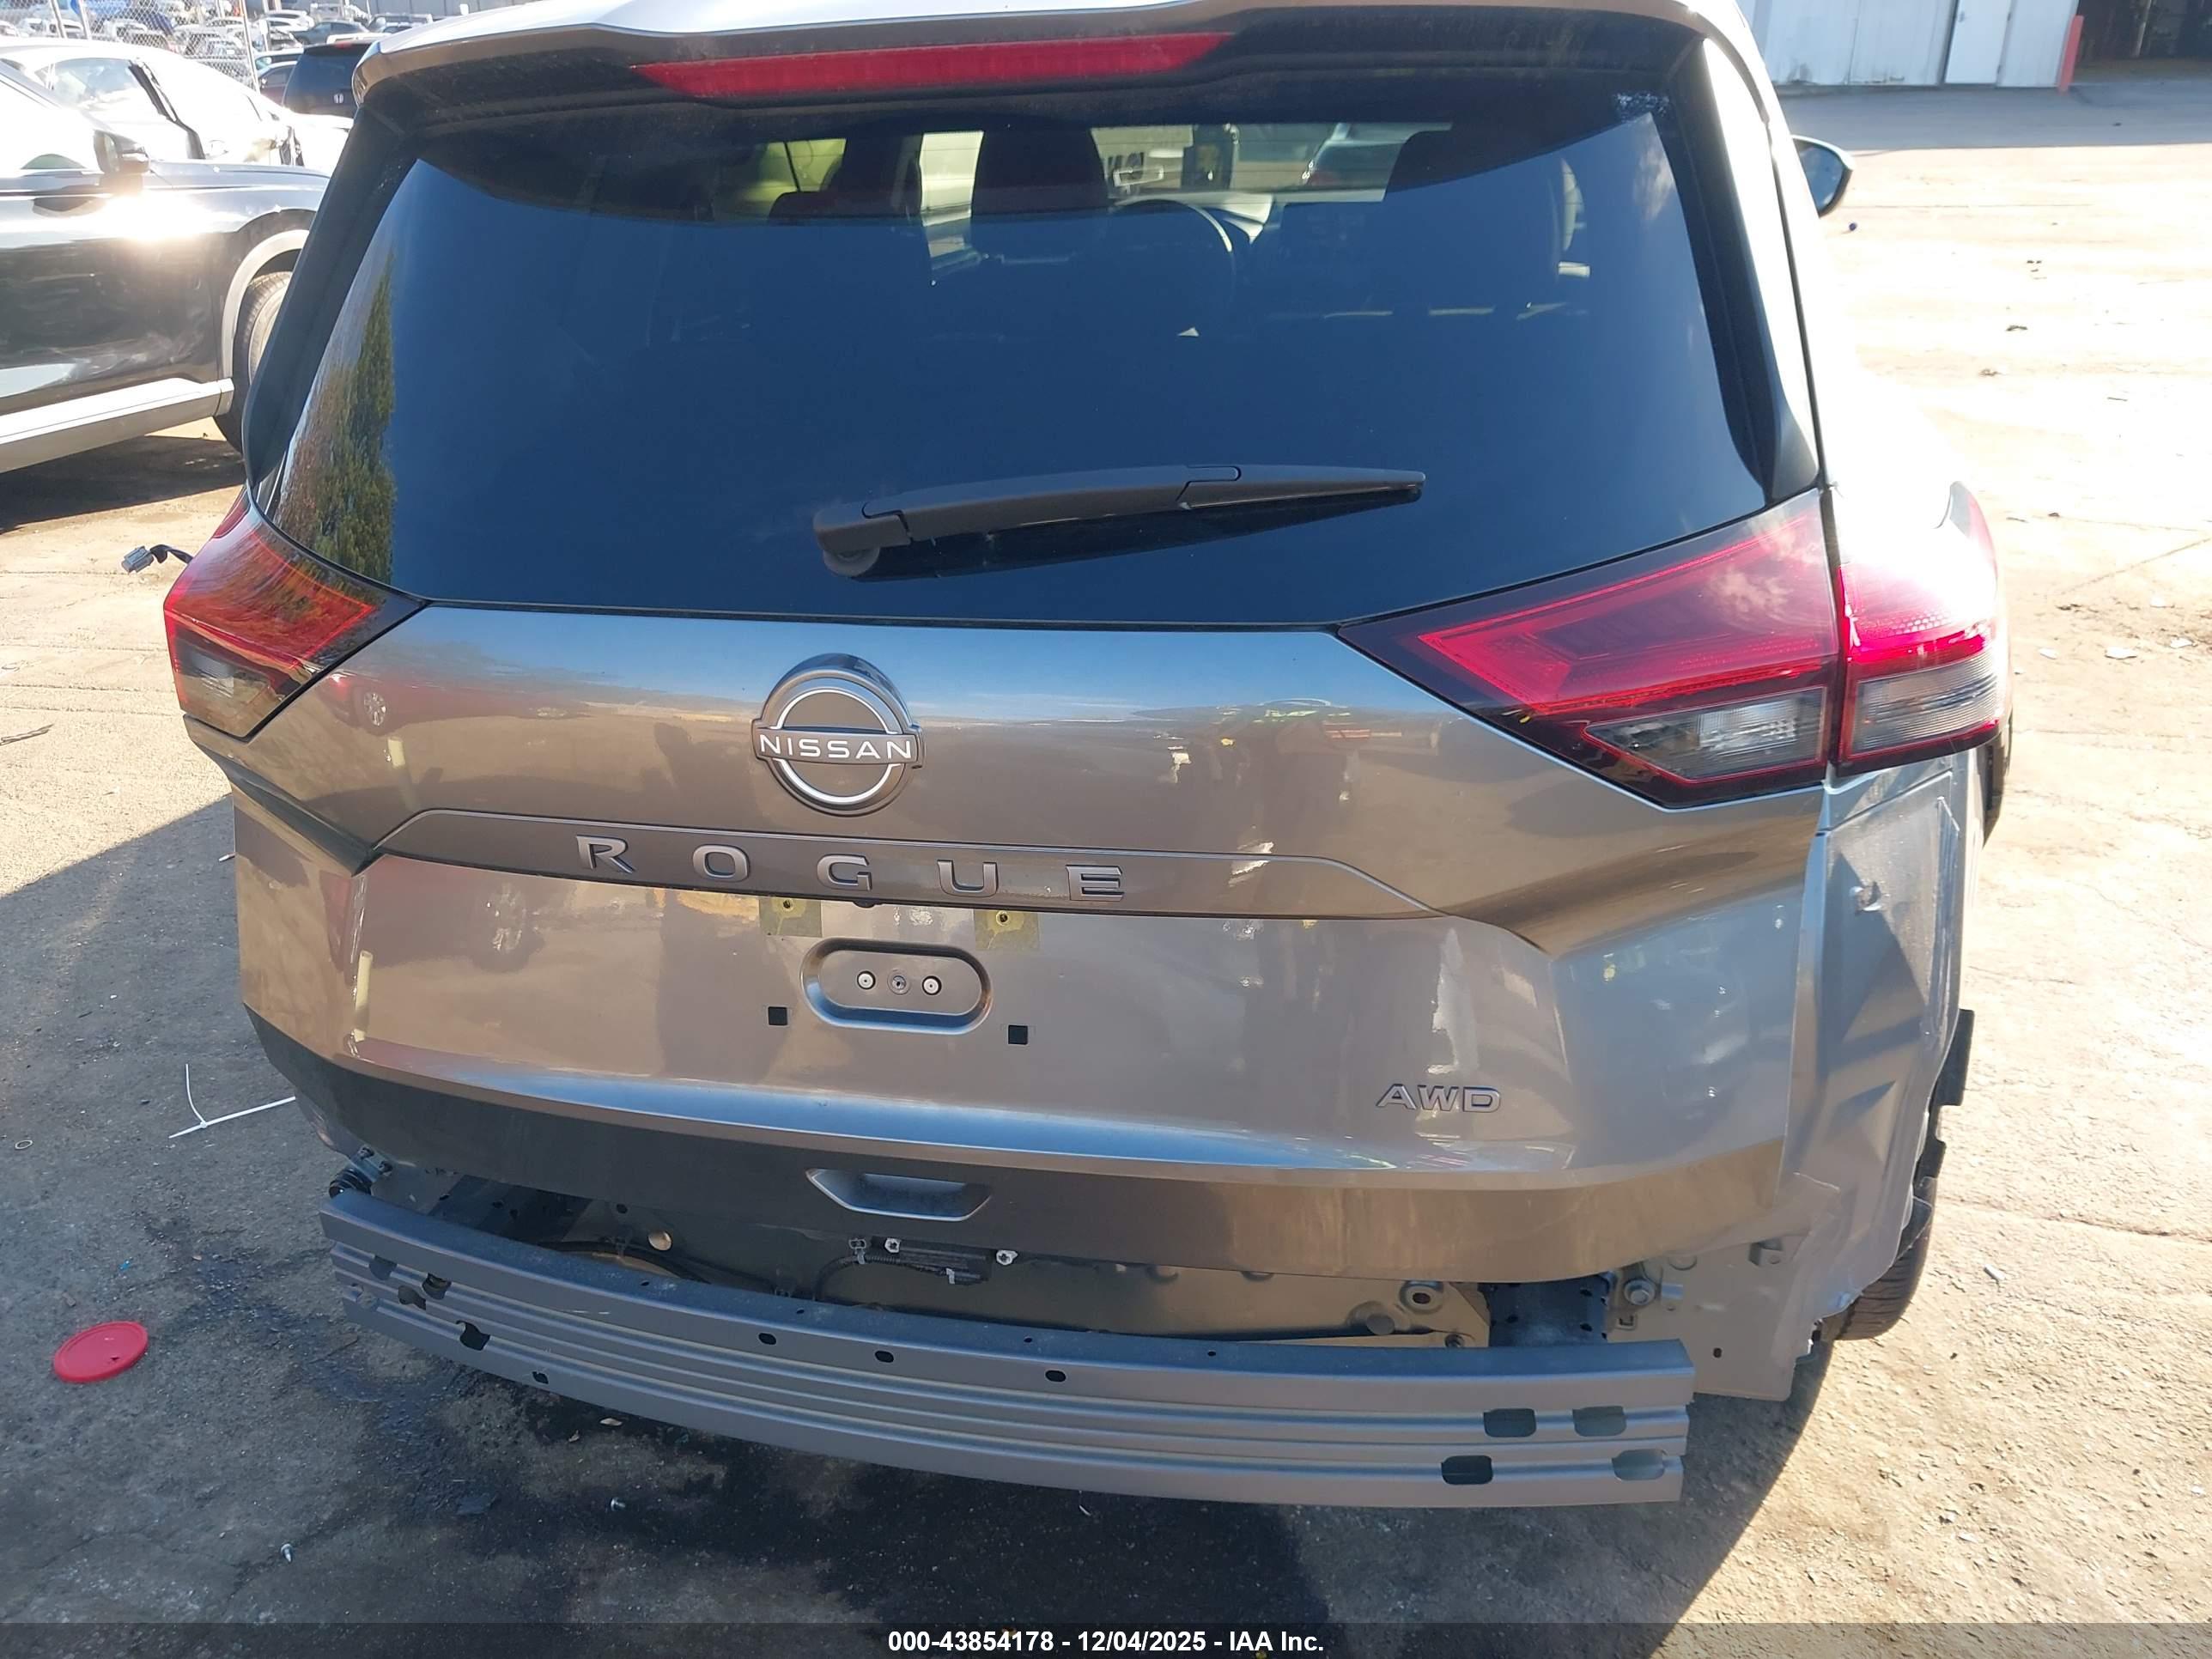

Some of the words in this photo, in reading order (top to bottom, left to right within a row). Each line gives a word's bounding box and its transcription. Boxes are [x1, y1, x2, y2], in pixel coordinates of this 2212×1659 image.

[759, 734, 912, 759] NISSAN
[575, 835, 1125, 902] ROGUE
[1376, 1083, 1501, 1114] AWD
